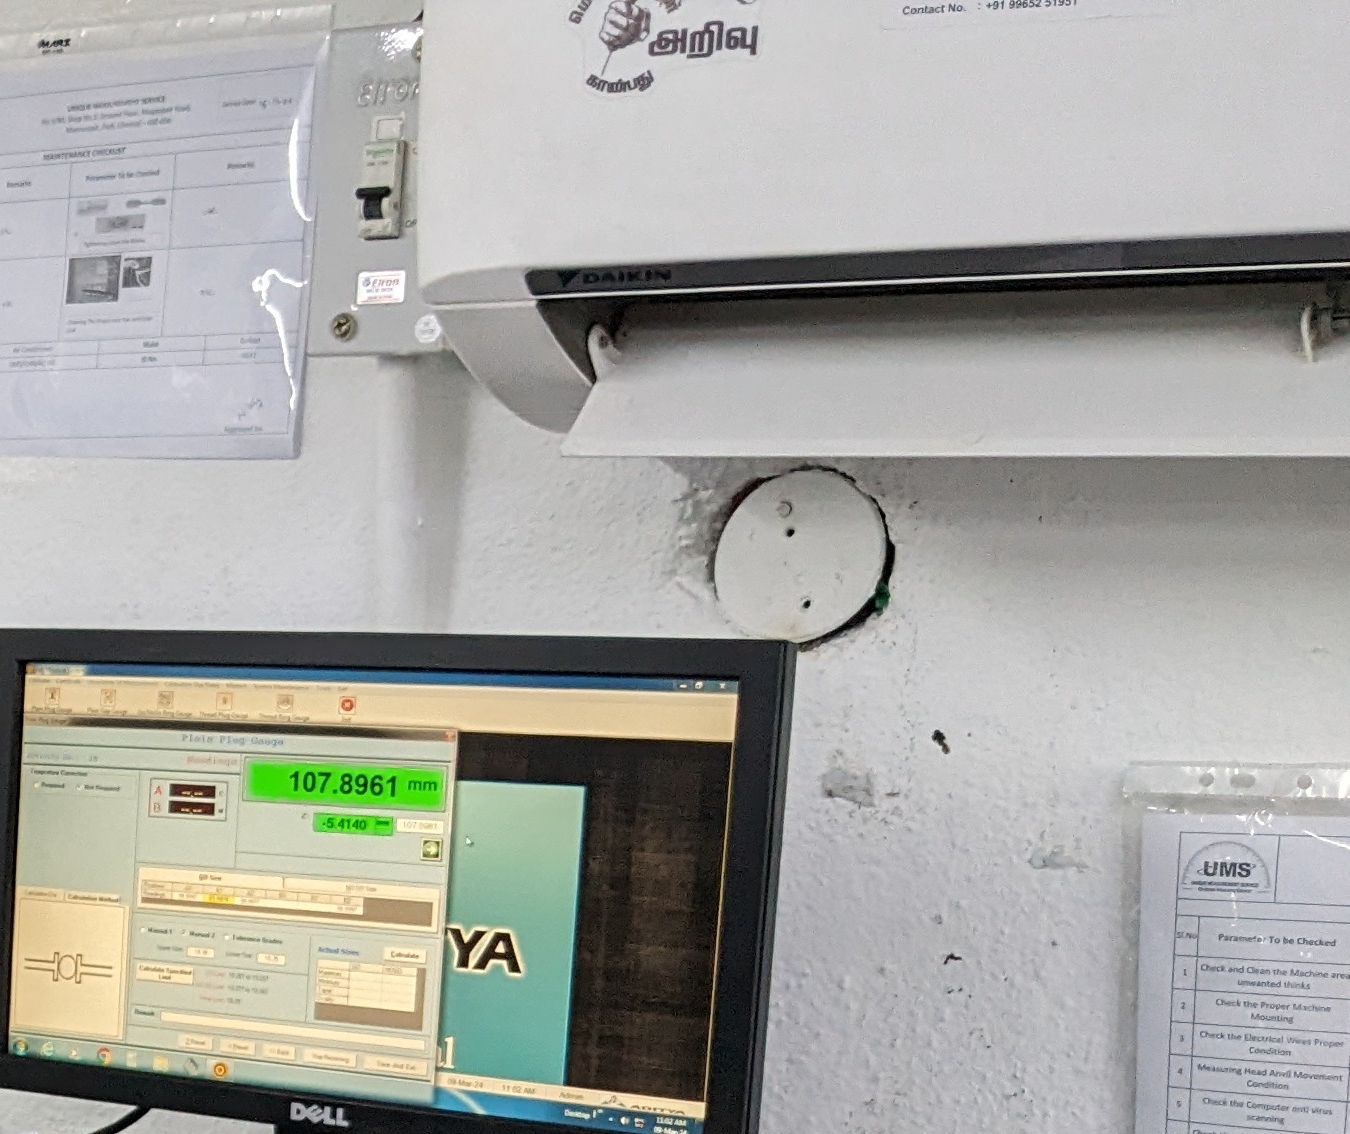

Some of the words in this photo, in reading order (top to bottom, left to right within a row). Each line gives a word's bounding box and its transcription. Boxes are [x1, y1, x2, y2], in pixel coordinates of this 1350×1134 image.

[902, 5, 945, 16] Contact
[948, 4, 966, 13] No.
[986, 0, 1005, 10] +91
[648, 20, 759, 59] அறிவு
[583, 269, 672, 285] DAIKIN
[289, 769, 398, 798] 107.8961
[407, 777, 438, 792] mm
[321, 816, 368, 831] -5.4140
[1203, 860, 1251, 878] UMS
[1218, 933, 1266, 943] Parameter
[1269, 936, 1281, 944] To
[1283, 937, 1294, 945] be
[1296, 937, 1337, 947] Checked
[446, 927, 522, 974] YA
[1183, 968, 1188, 977] 1
[1200, 963, 1225, 973] Check
[1227, 965, 1244, 974] and
[1246, 966, 1271, 976] Clean
[1273, 969, 1287, 977] the
[1290, 969, 1329, 979] Machine
[1237, 979, 1281, 988] unwanted
[1181, 1002, 1186, 1010] 2
[1215, 998, 1241, 1008] Check
[1243, 1000, 1258, 1008] the
[1260, 1001, 1290, 1012] Proper
[1292, 1003, 1332, 1013] Machine
[1250, 1013, 1294, 1024] Mounting
[1179, 1034, 1184, 1042] 3
[1199, 1030, 1225, 1040] Check
[1227, 1032, 1242, 1041] the
[1244, 1033, 1284, 1044] Electrical
[1313, 1039, 1344, 1049] Proper
[1249, 1046, 1292, 1056] Condition
[1177, 1067, 1183, 1075] 4
[1197, 1063, 1243, 1075] Measuring
[1244, 1068, 1267, 1077] Head
[1269, 1069, 1291, 1079] Anvil
[1293, 1071, 1343, 1082] Movement
[1246, 1080, 1289, 1090] Condition
[1176, 1100, 1182, 1108] 5
[1202, 1097, 1228, 1106] Check
[1229, 1099, 1244, 1108] the
[1246, 1100, 1289, 1112] Computer
[290, 1101, 350, 1128] DELL
[1246, 1114, 1285, 1125] scanning
